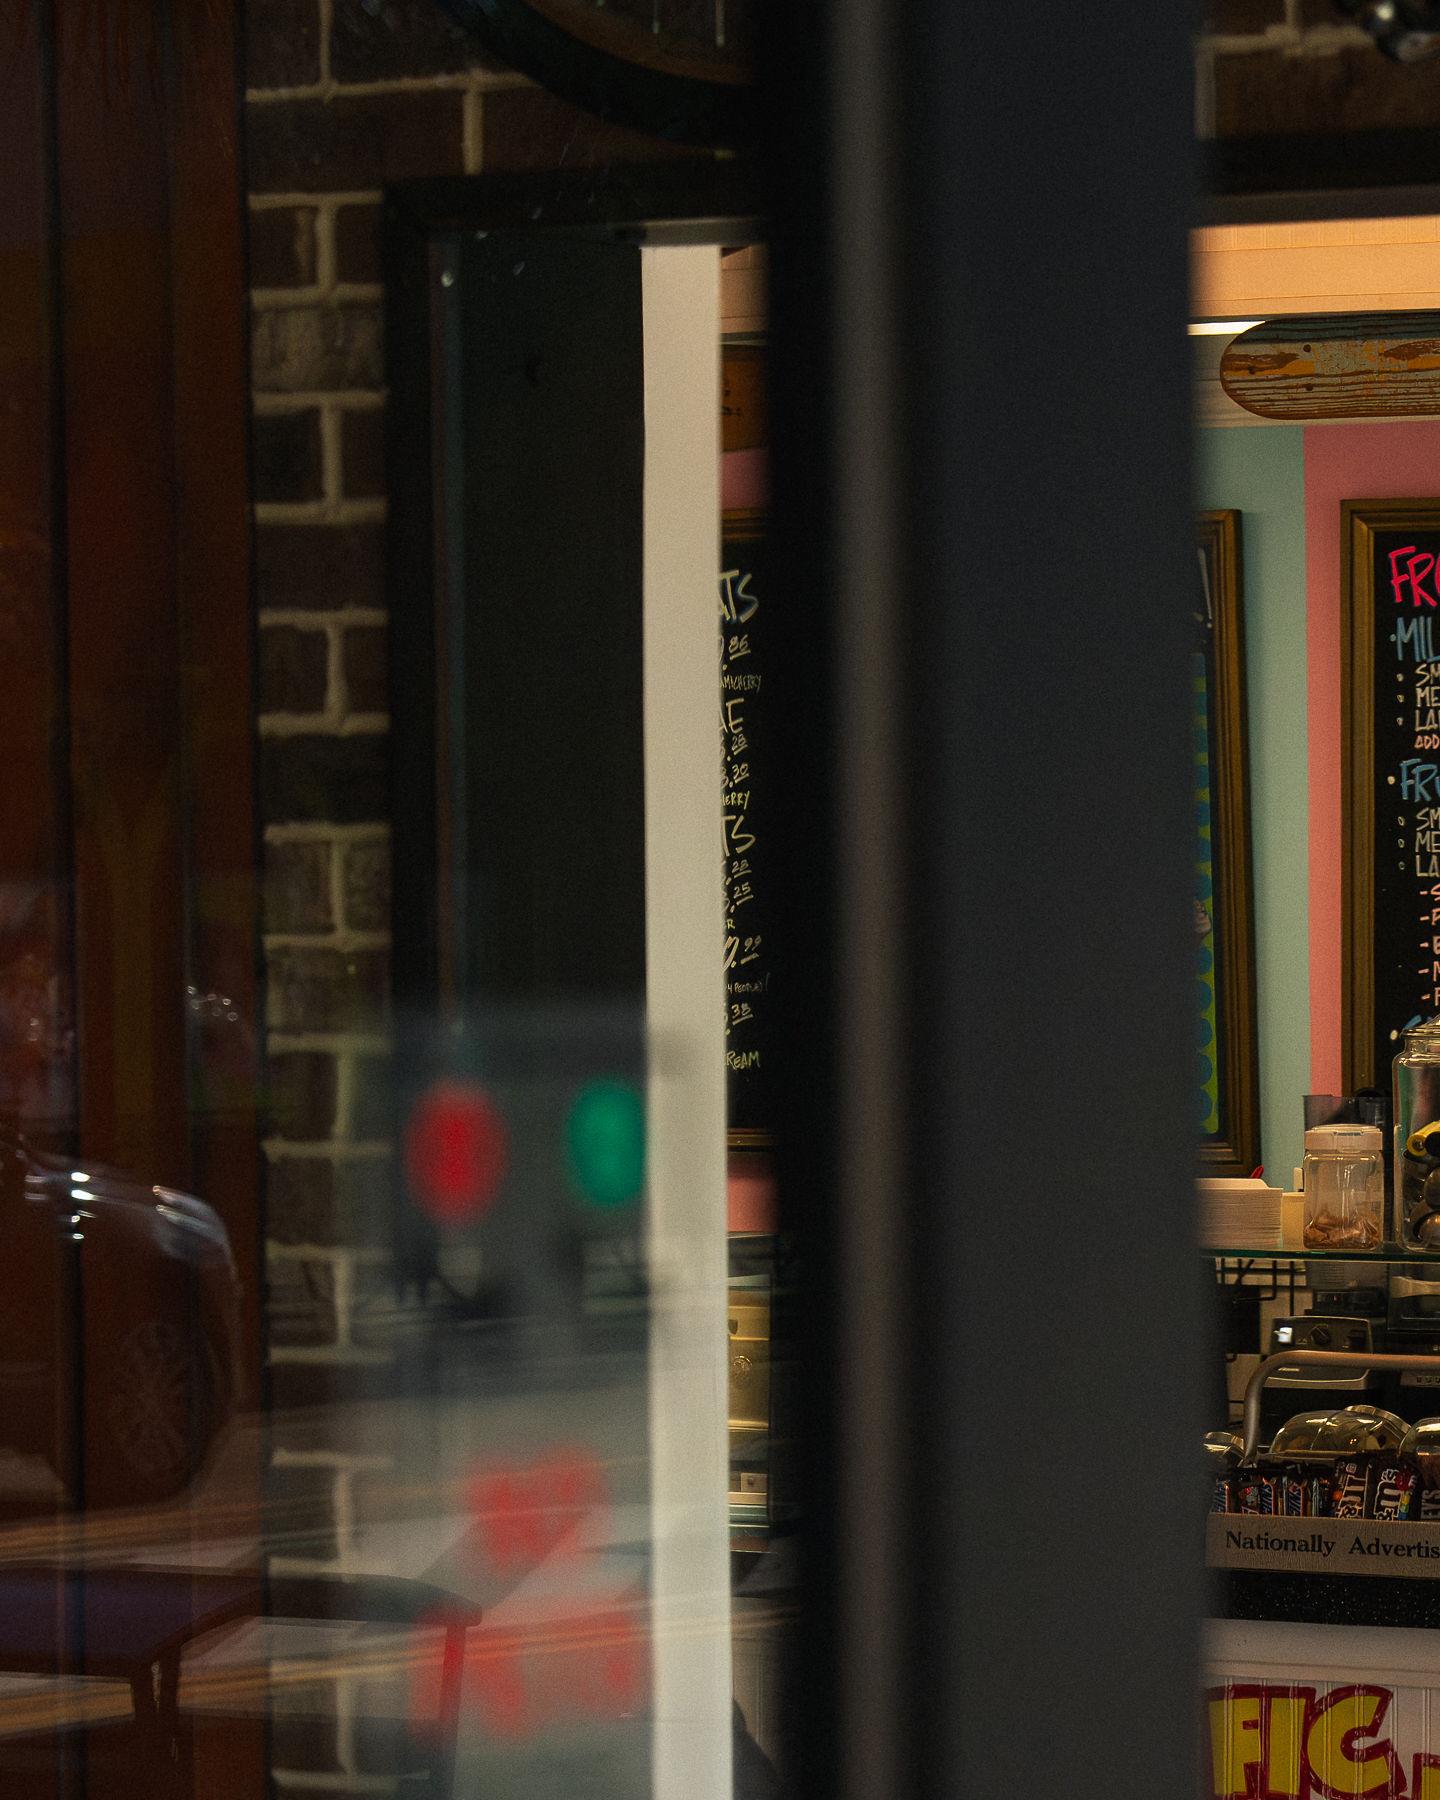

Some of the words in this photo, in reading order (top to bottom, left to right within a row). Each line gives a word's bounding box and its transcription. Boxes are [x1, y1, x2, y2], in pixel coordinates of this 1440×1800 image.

[719, 570, 759, 623] TS
[1414, 734, 1440, 749] ADD
[1225, 1530, 1336, 1557] Nationally
